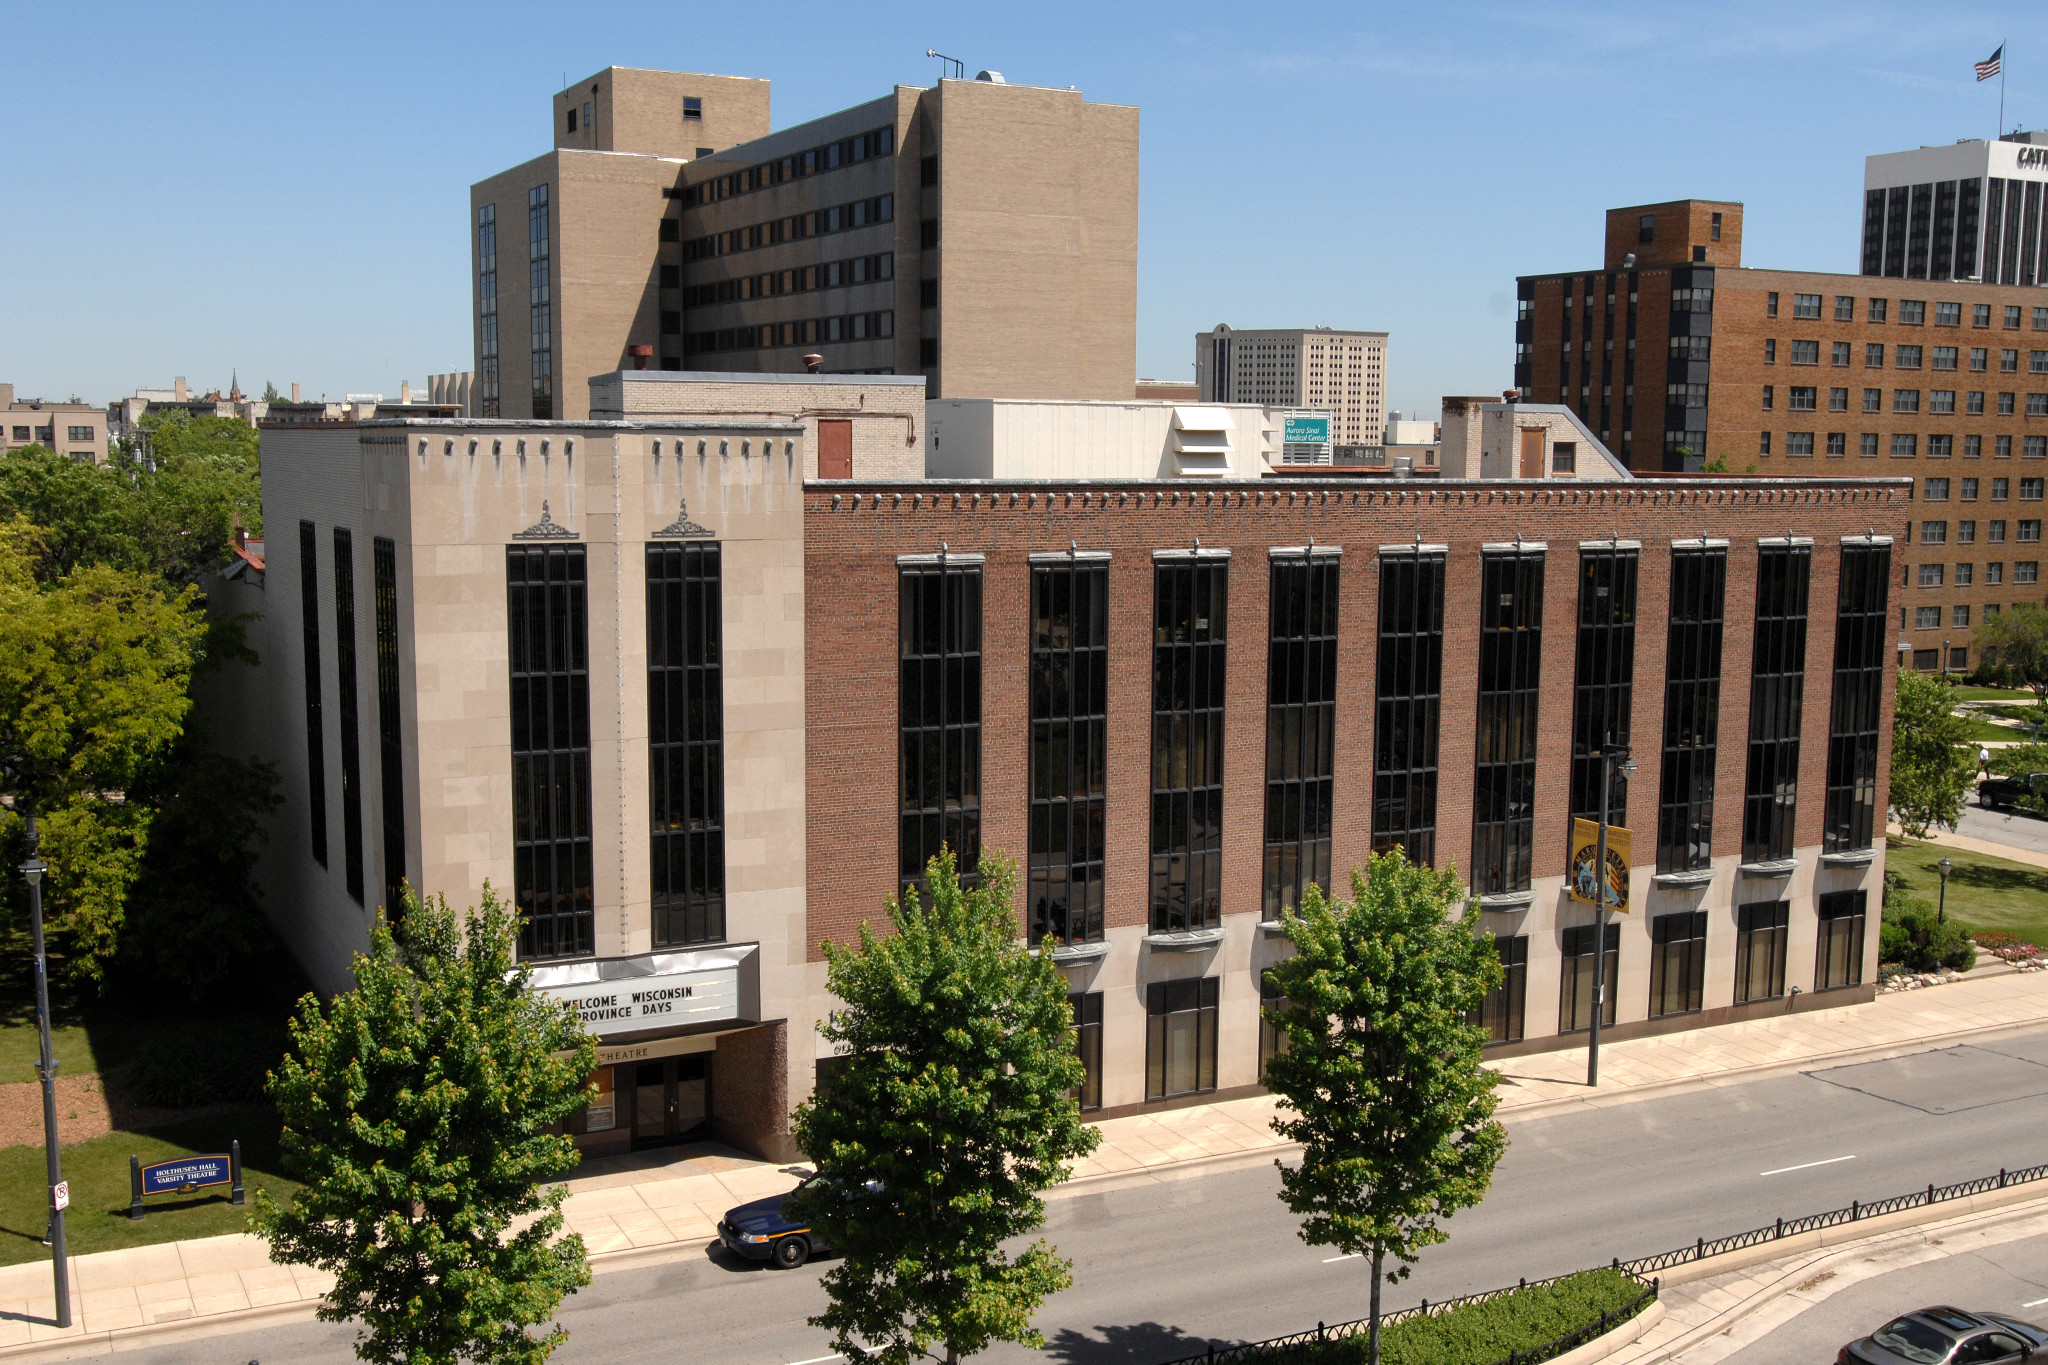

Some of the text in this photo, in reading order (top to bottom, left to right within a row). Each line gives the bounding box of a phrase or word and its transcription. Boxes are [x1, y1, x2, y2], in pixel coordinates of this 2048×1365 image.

[632, 987, 692, 1003] WISCONSIN
[577, 1002, 672, 1021] PROVINCE DAYS
[156, 1162, 216, 1176] HOLTHUSEN HALL
[157, 1170, 217, 1184] VARSITY THEATRE
